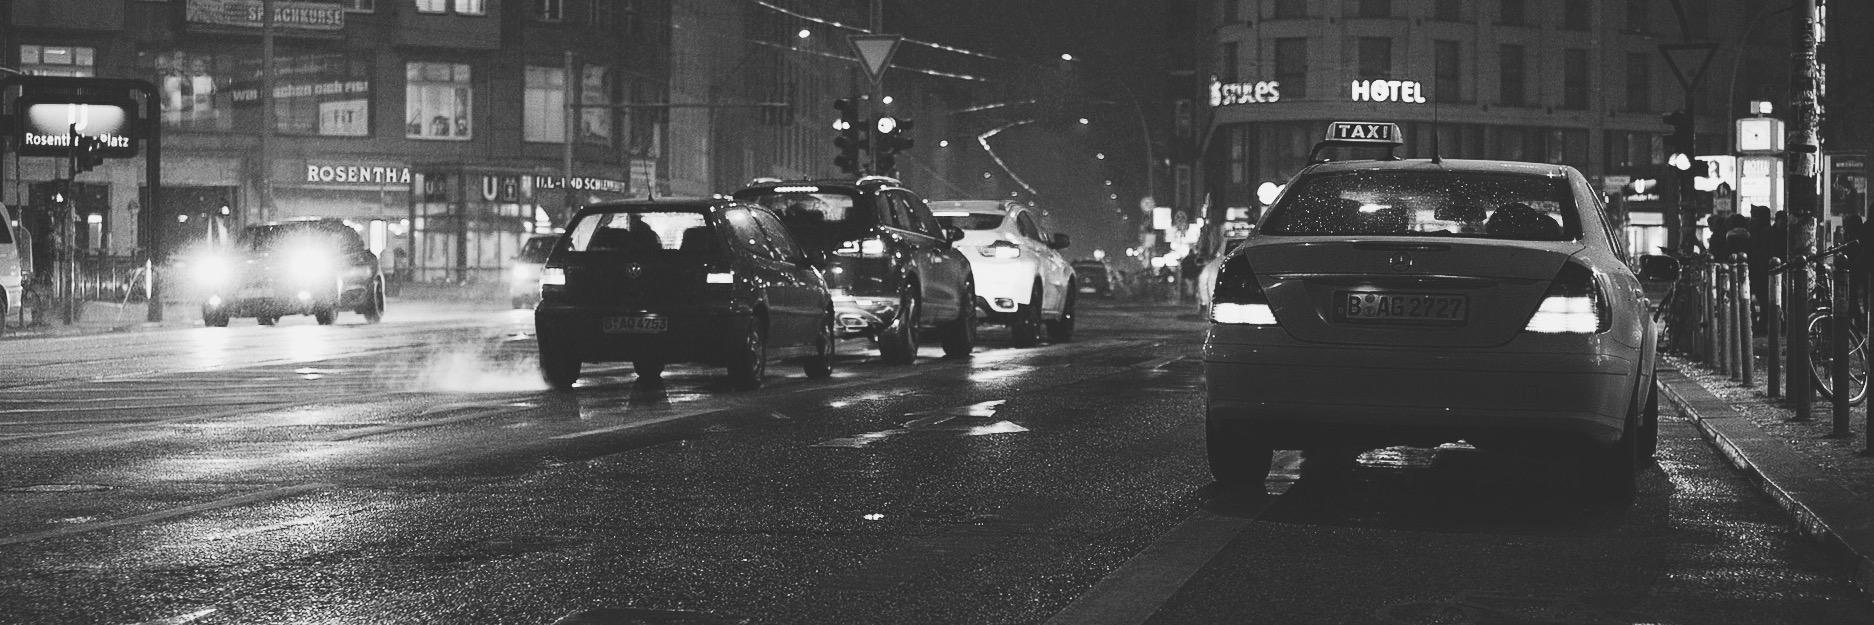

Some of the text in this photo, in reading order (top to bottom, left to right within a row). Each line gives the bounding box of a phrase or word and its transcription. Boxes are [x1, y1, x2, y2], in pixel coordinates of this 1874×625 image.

[248, 7, 341, 25] SPACHKURSE
[1351, 79, 1426, 104] HOTEL
[1338, 124, 1388, 139] TAXI
[307, 165, 411, 183] ROSENTHA
[481, 176, 496, 201] U
[1348, 295, 1463, 319] B AG 2727
